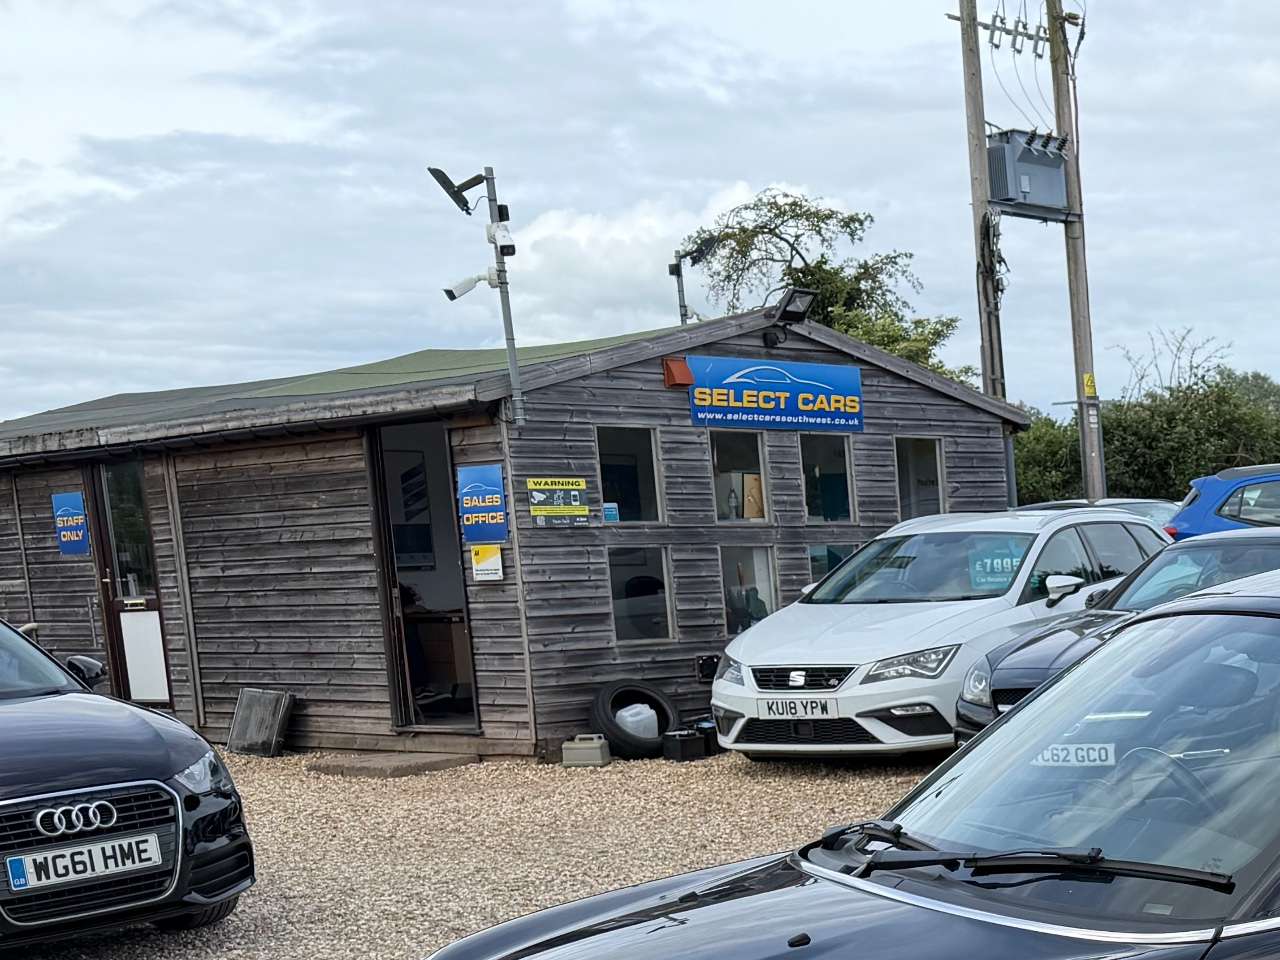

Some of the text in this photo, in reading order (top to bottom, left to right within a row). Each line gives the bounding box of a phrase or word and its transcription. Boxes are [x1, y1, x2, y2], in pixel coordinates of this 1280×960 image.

[694, 387, 860, 412] SELECT CARS
[697, 411, 859, 425] www.selectcarssouthwest.co.uk
[463, 495, 501, 507] SALES
[56, 516, 85, 527] STAFF
[464, 512, 504, 525] OFFICE
[60, 530, 83, 541] ONLY
[766, 701, 829, 716] KU18 YPW
[1033, 747, 1109, 763] C62 GCO
[32, 839, 153, 882] WG61 HME
